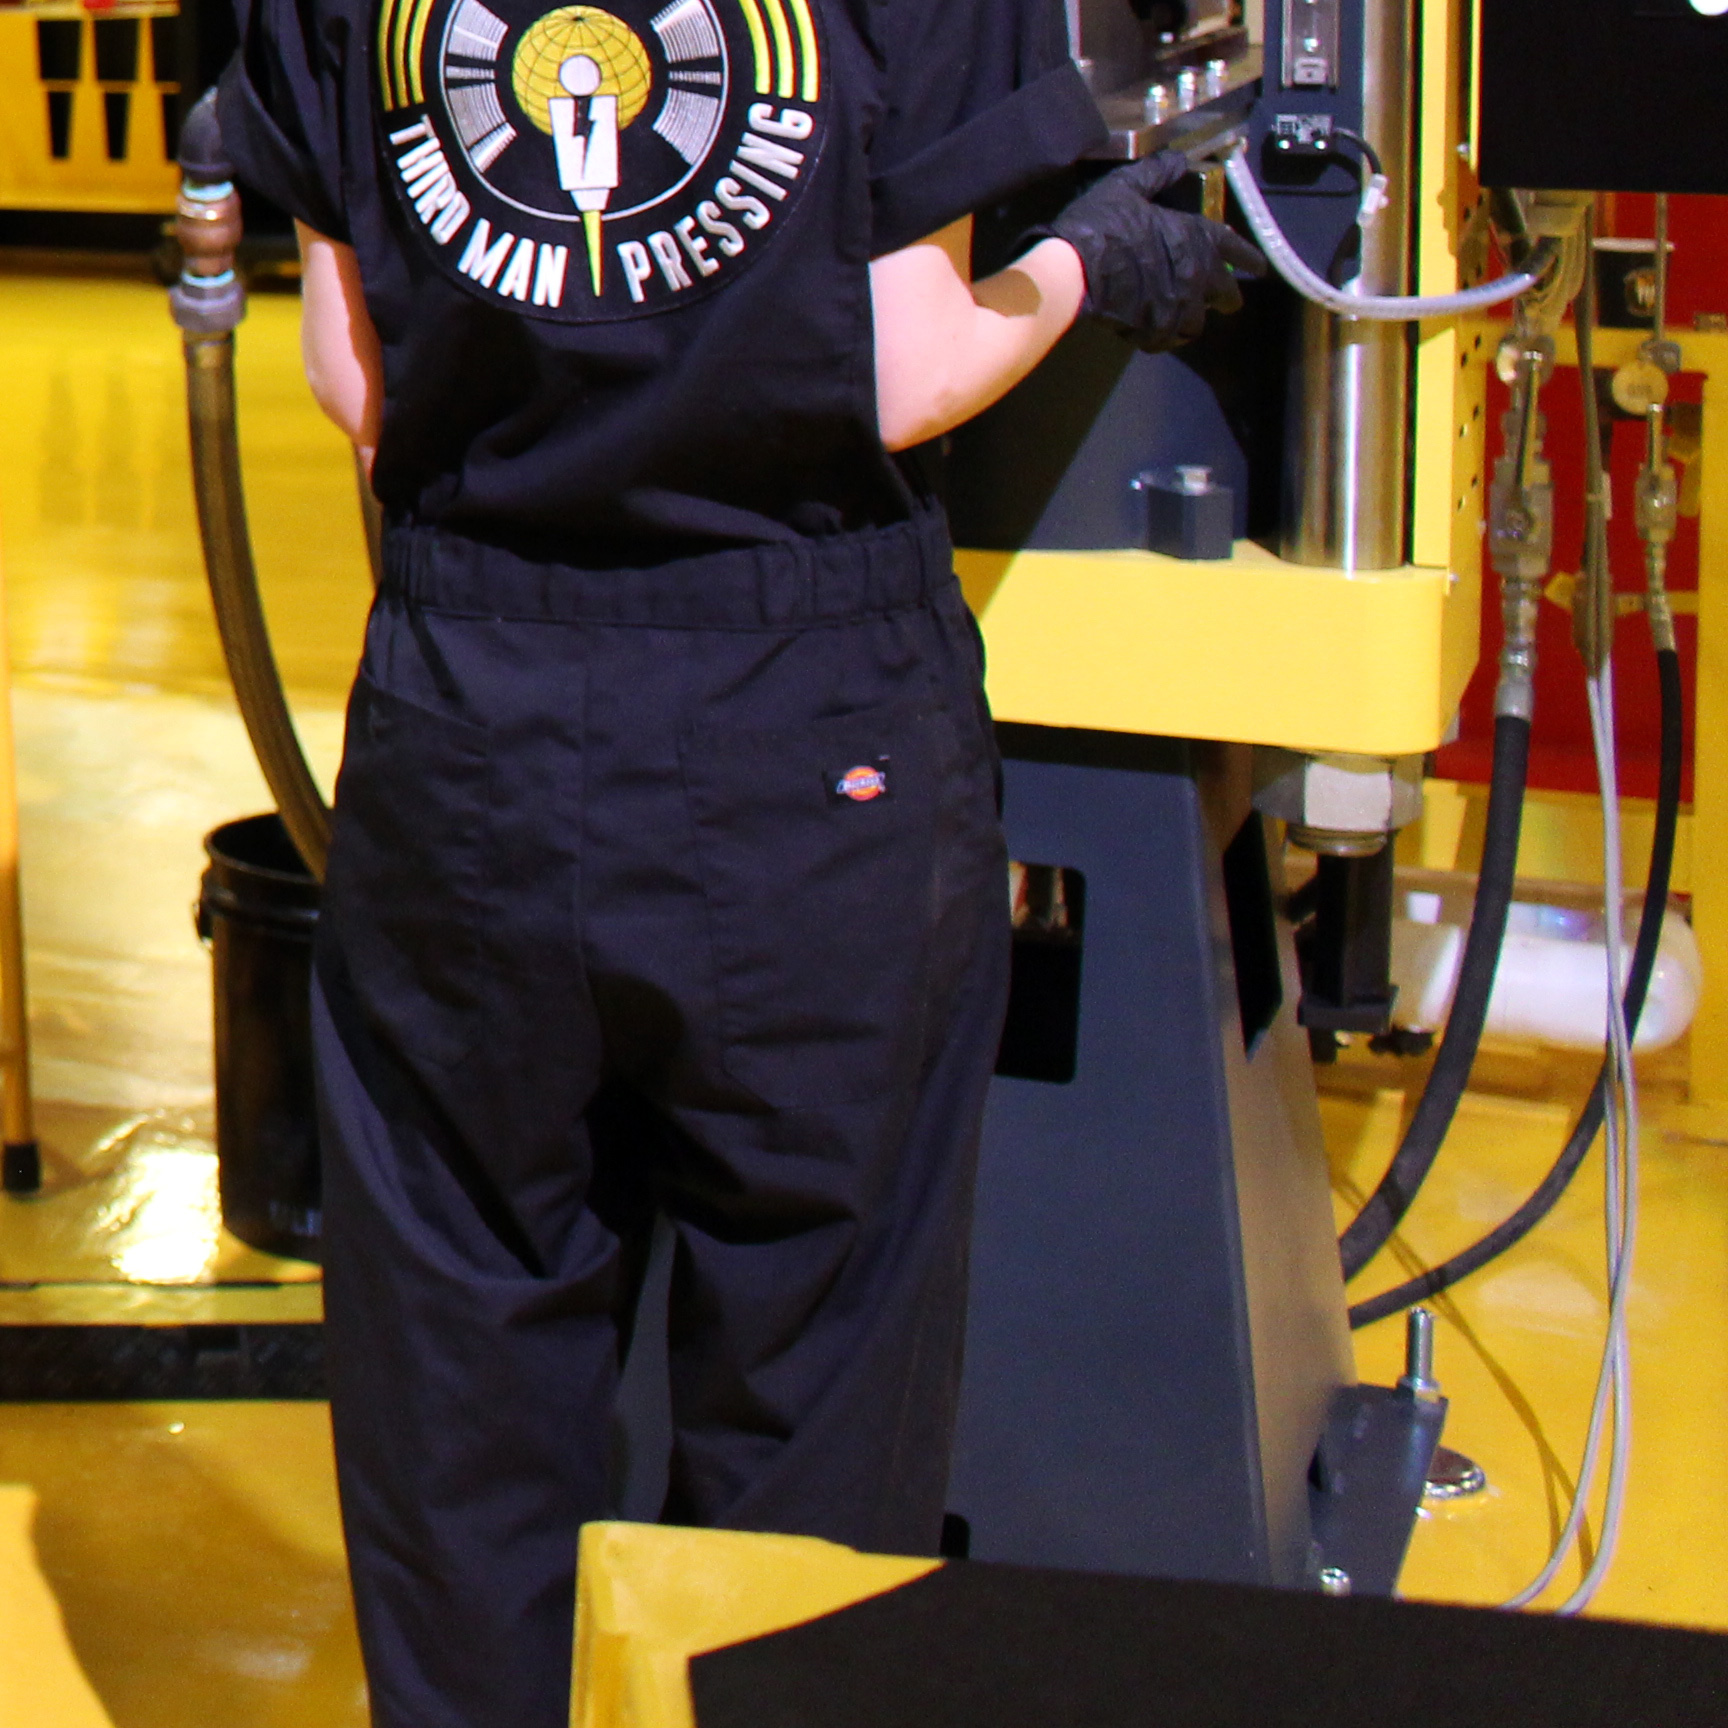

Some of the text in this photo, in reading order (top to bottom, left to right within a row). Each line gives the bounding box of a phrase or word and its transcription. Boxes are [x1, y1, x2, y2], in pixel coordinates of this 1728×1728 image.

[388, 100, 815, 309] THIRD MAN PRESSING
